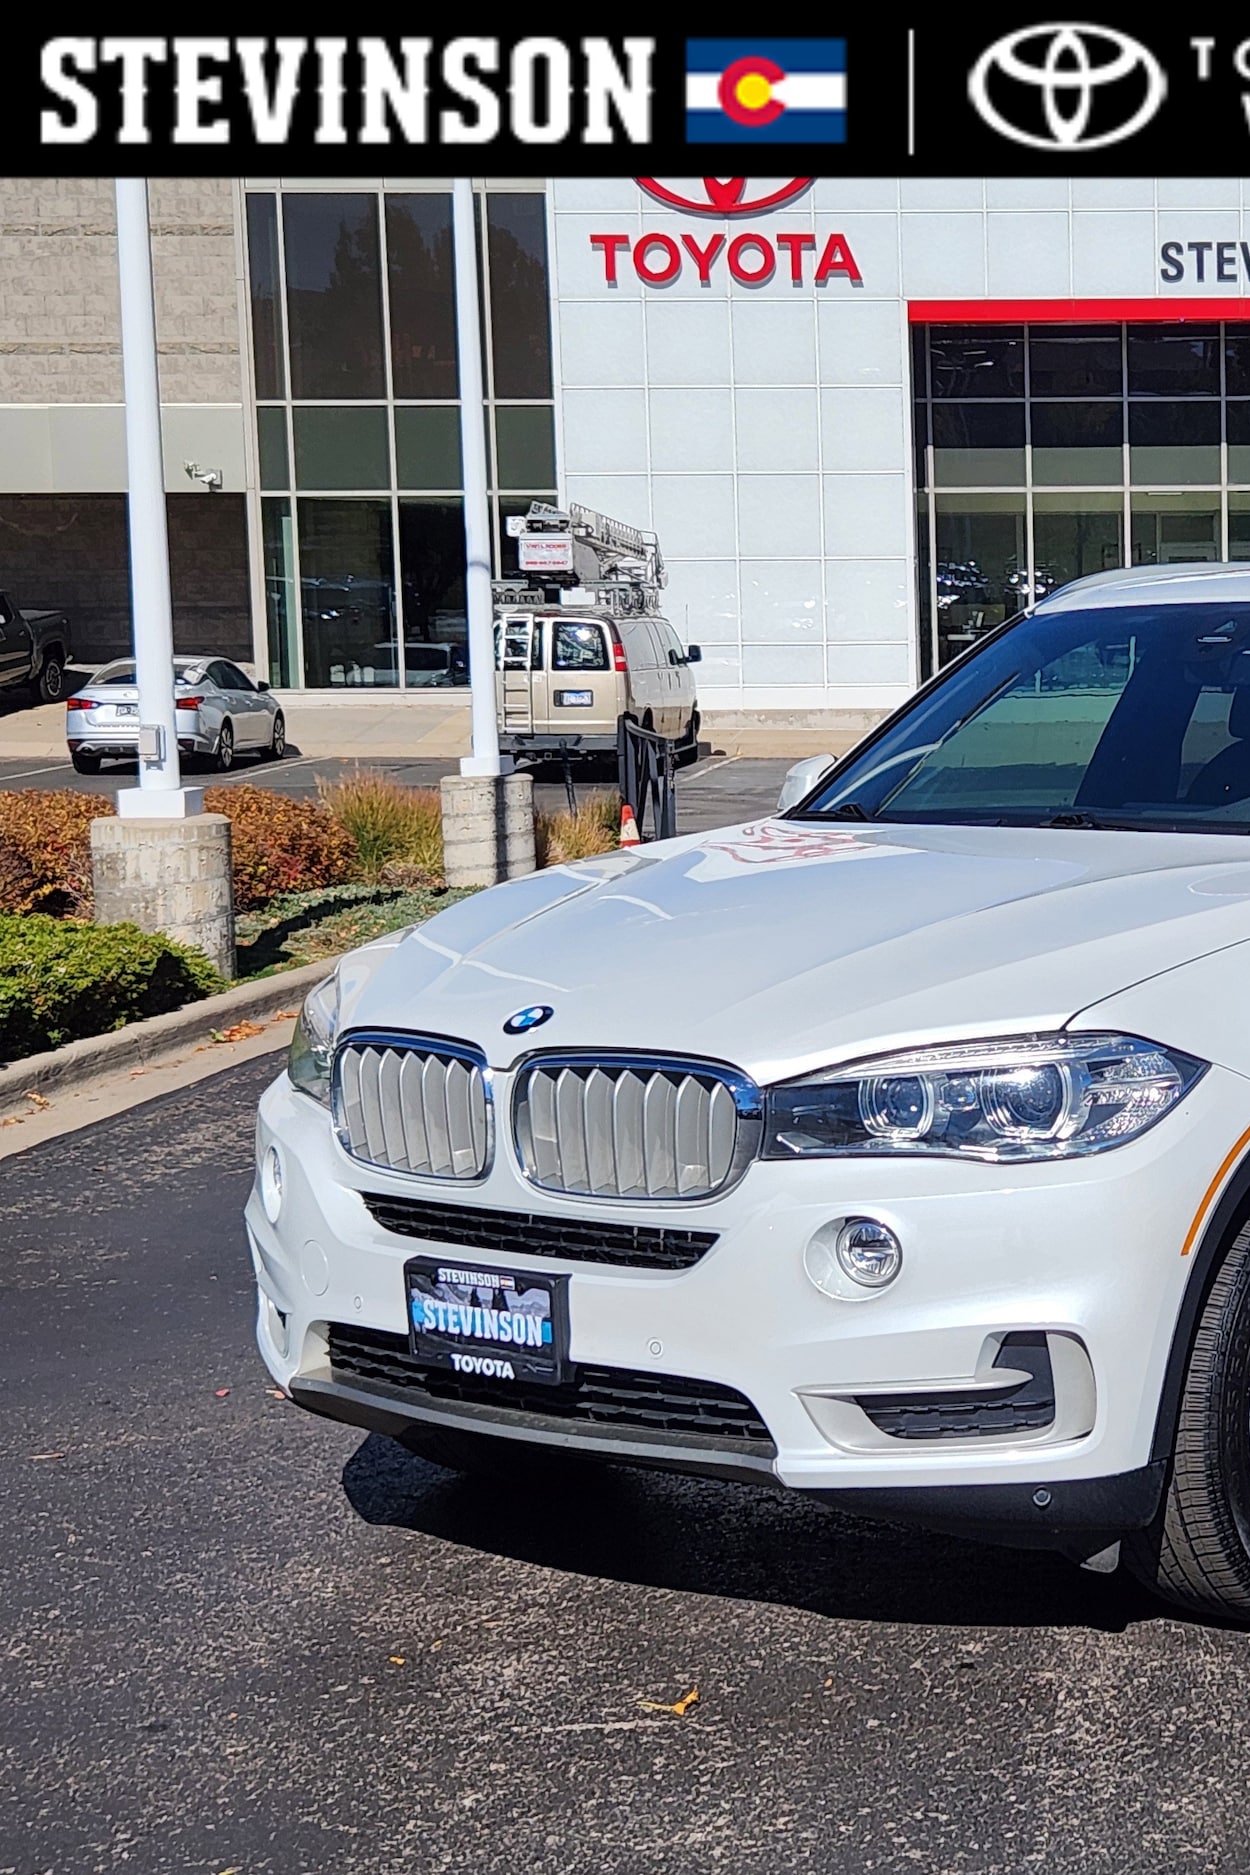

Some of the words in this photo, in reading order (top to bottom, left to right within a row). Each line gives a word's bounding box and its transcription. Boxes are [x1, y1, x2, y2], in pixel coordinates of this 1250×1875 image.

[591, 233, 862, 284] TOYOTA
[437, 1267, 501, 1288] STEVINSON
[423, 1300, 543, 1347] STEVINSON
[450, 1353, 515, 1380] TOYOTA
